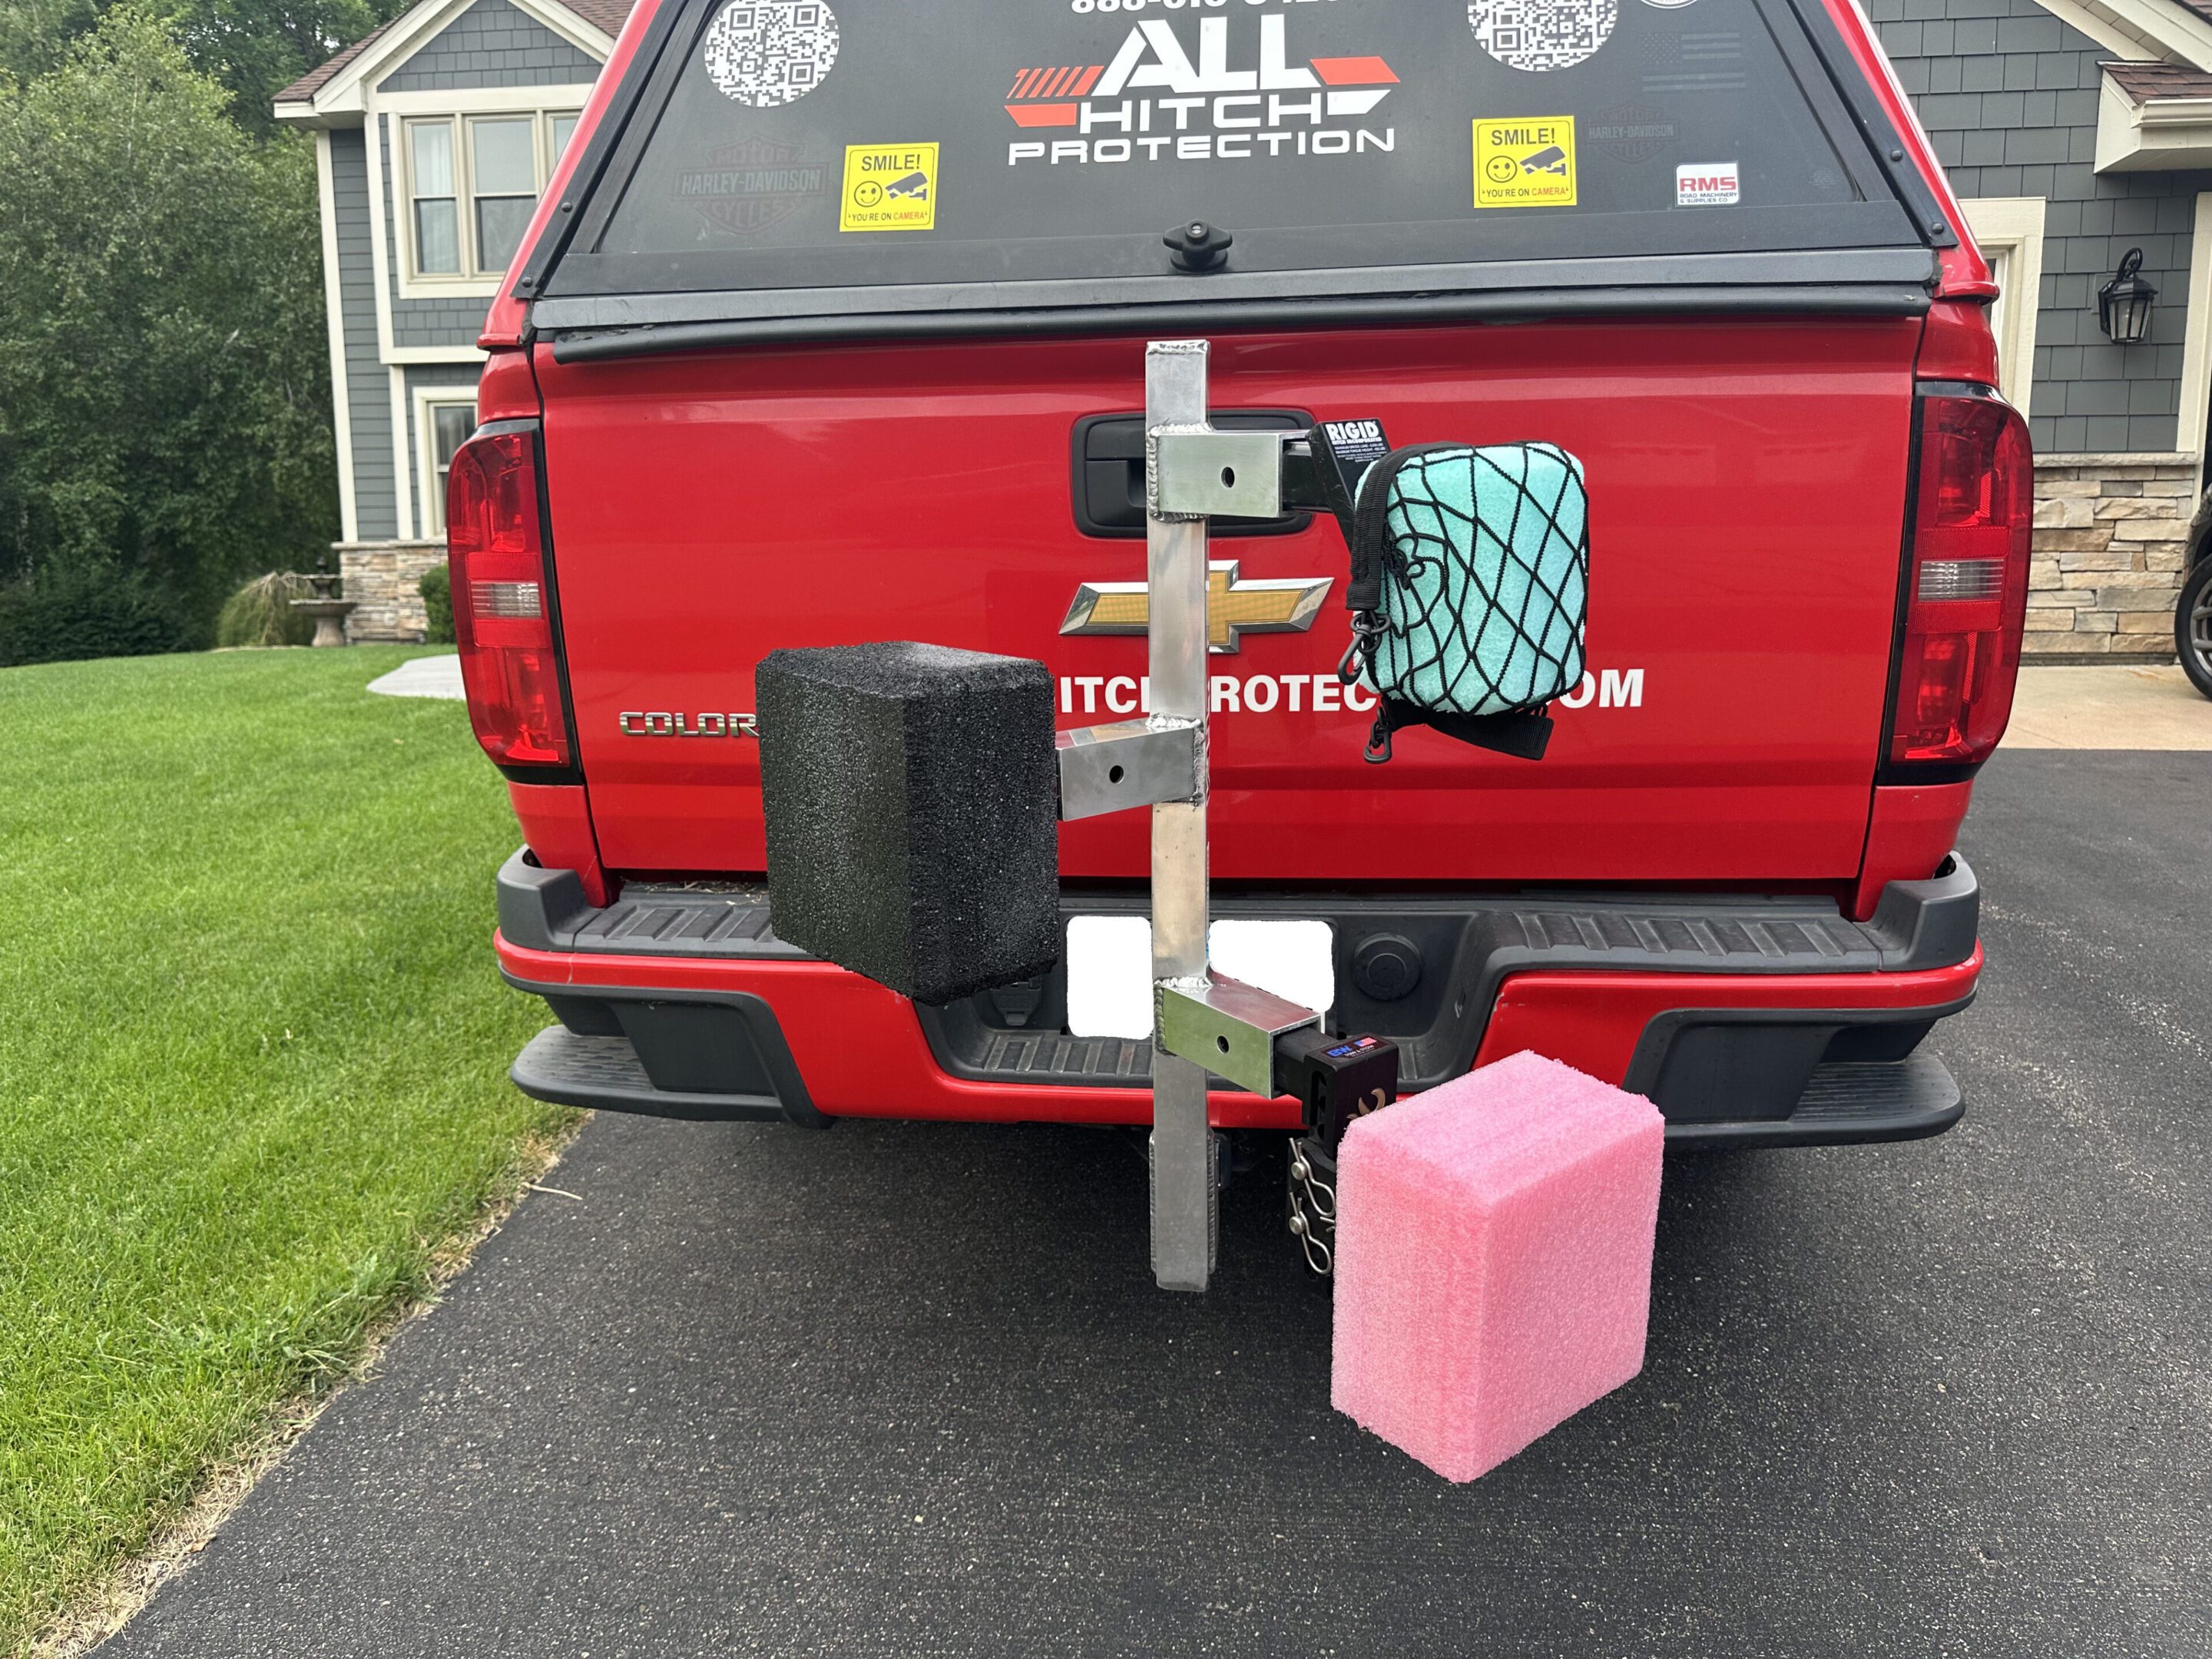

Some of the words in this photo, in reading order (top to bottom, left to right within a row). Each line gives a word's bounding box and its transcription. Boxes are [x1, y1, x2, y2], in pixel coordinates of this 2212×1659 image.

[1091, 14, 1321, 97] ALL
[1079, 92, 1322, 134] HITCH
[1491, 127, 1555, 146] SMILE!
[1588, 124, 1674, 139] HARLEY-DAVIDSON
[1008, 128, 1395, 165] PROTECTION
[861, 154, 920, 171] SMILE!
[681, 169, 821, 195] HARLEY-DAVIDSON
[1679, 177, 1737, 192] RMS
[1518, 188, 1530, 197] ON
[881, 212, 891, 220] ON
[1325, 421, 1379, 440] RIGID
[619, 711, 760, 737] COLOR
